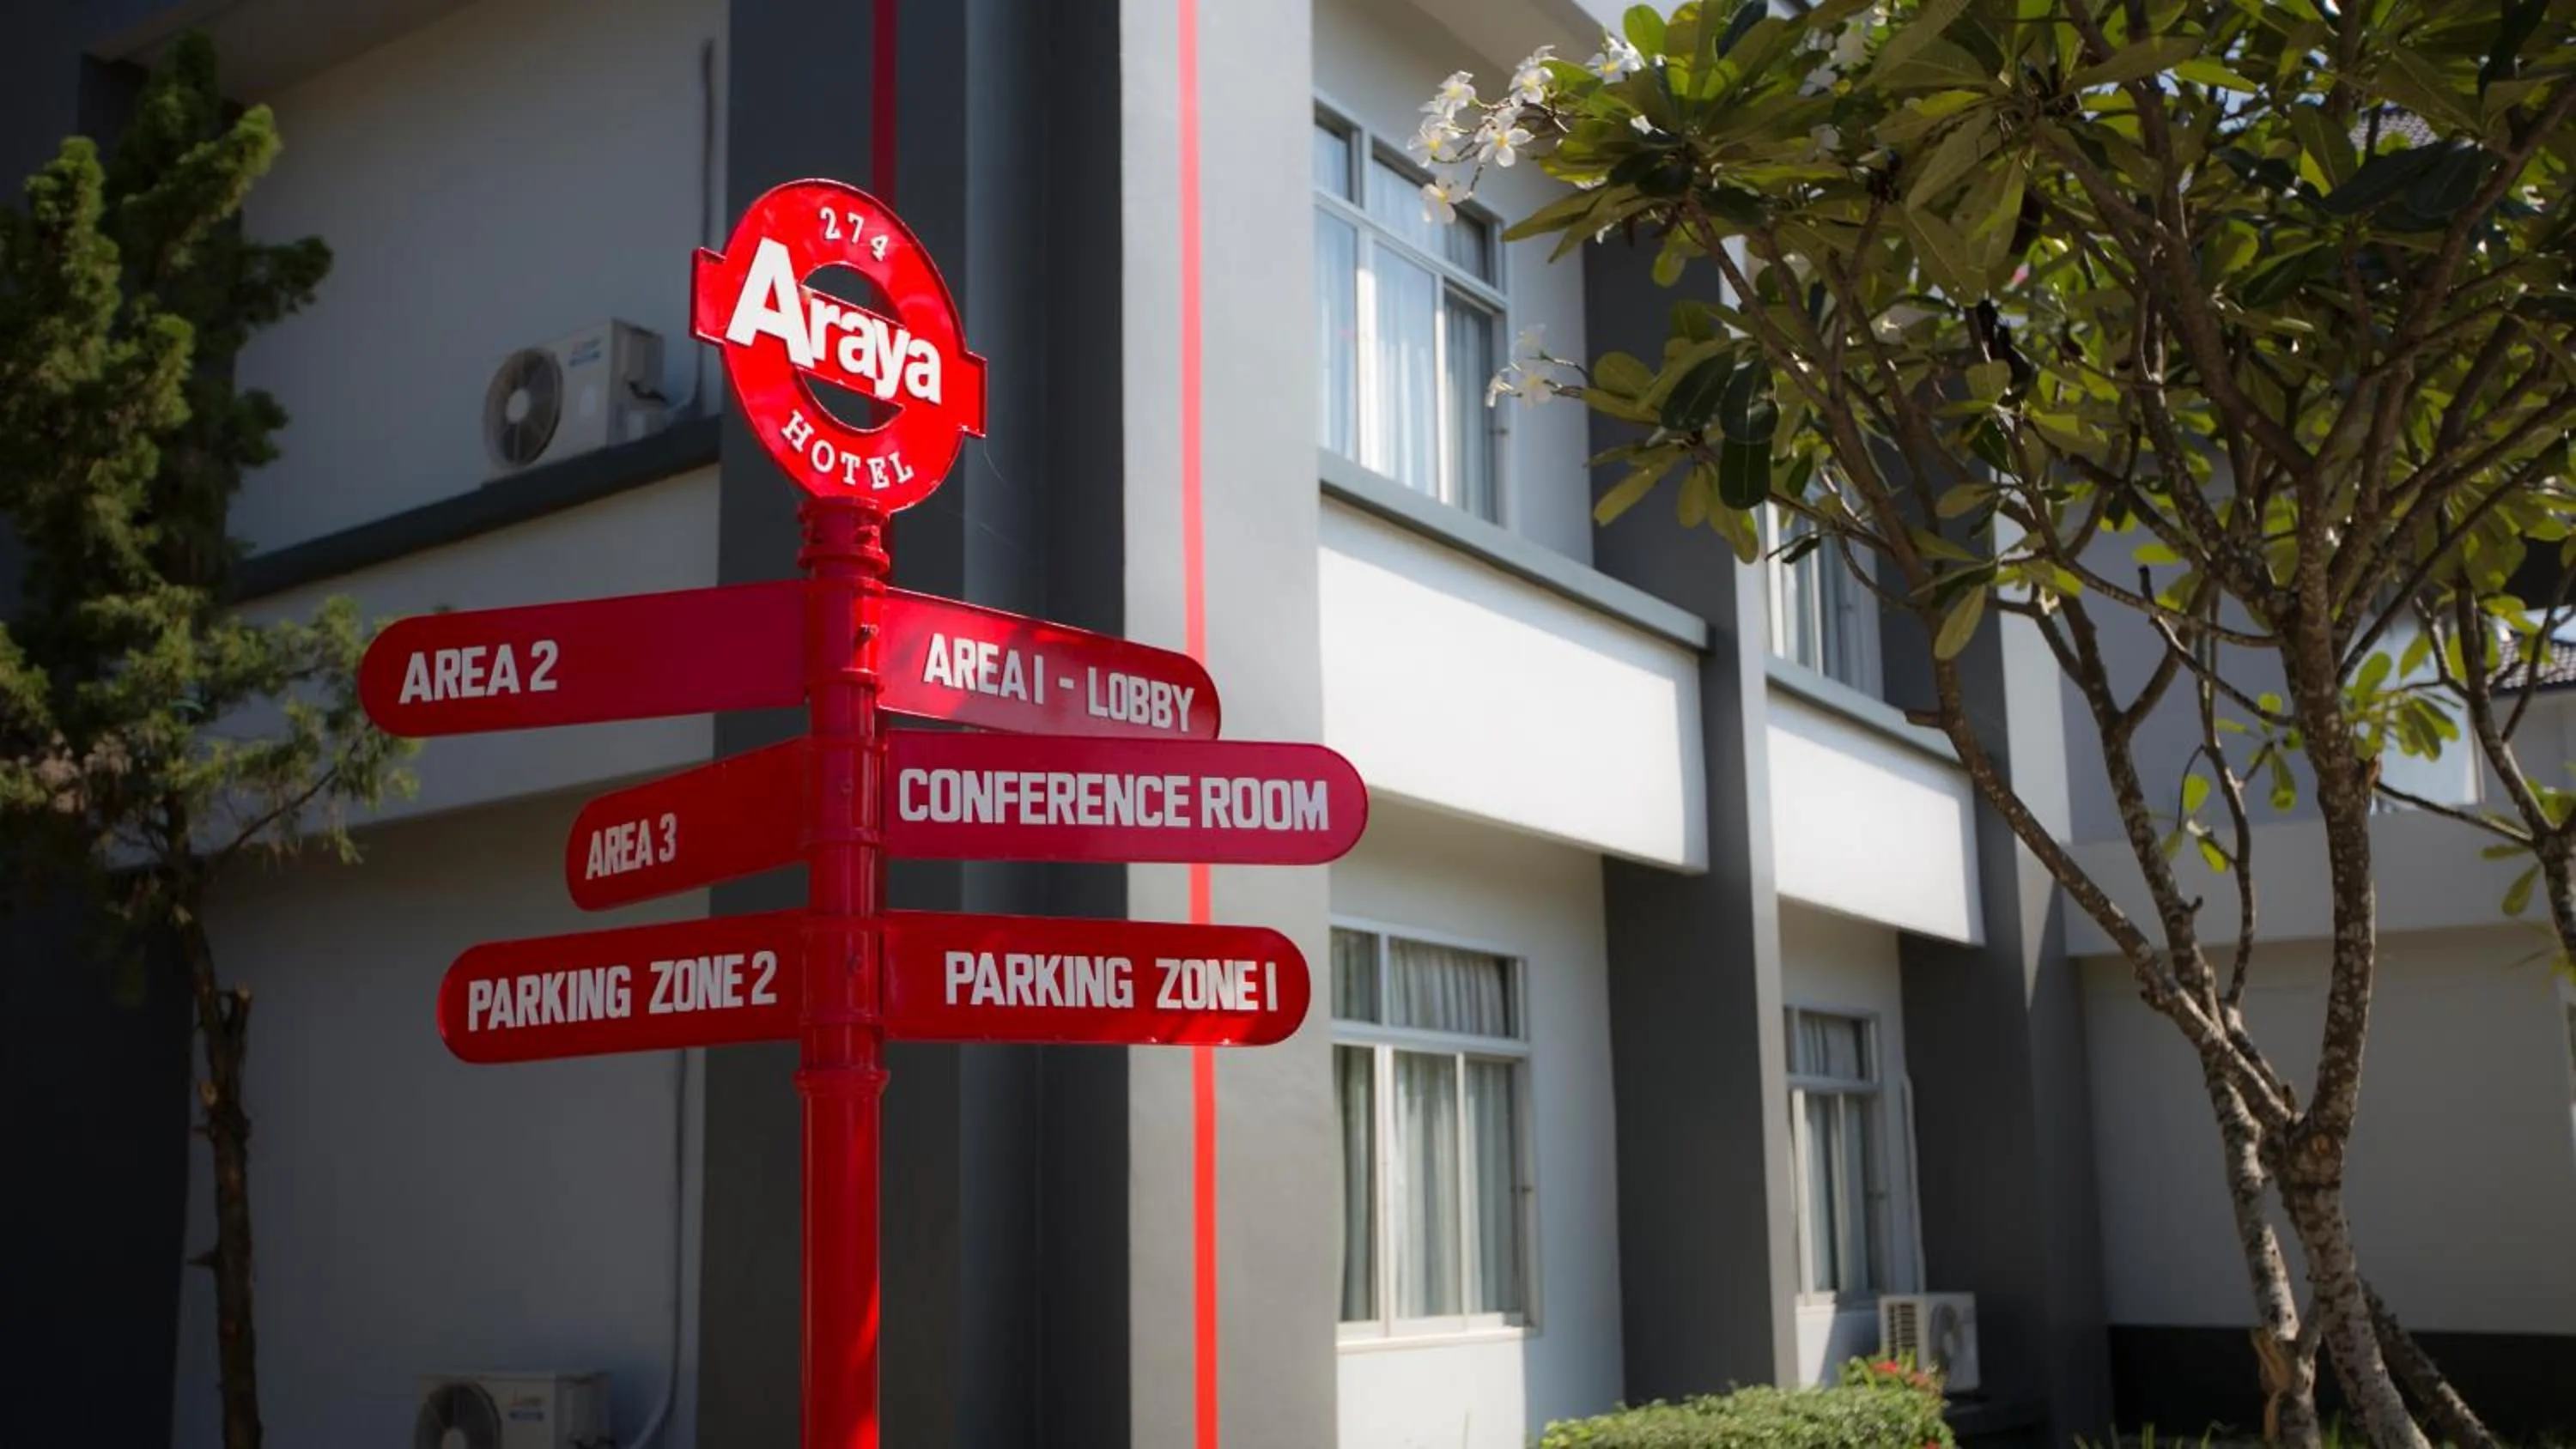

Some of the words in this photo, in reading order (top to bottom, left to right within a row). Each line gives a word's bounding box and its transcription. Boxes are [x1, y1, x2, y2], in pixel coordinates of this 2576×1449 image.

[820, 207, 889, 261] 274
[726, 237, 942, 404] Araya
[781, 410, 914, 490] HOTEL
[399, 644, 520, 704] AREA
[530, 640, 558, 691] 2
[1087, 666, 1194, 732] LOBBY
[899, 768, 1191, 828] CONFERENCE
[1200, 777, 1329, 831] ROOM
[586, 819, 653, 880] AREA
[659, 812, 677, 863] 3
[468, 966, 630, 1032] PARKING
[649, 953, 744, 1014] ZONE
[751, 950, 777, 1004] 2
[945, 951, 1133, 1009] PARKING
[1156, 958, 1258, 1011] ZONE
